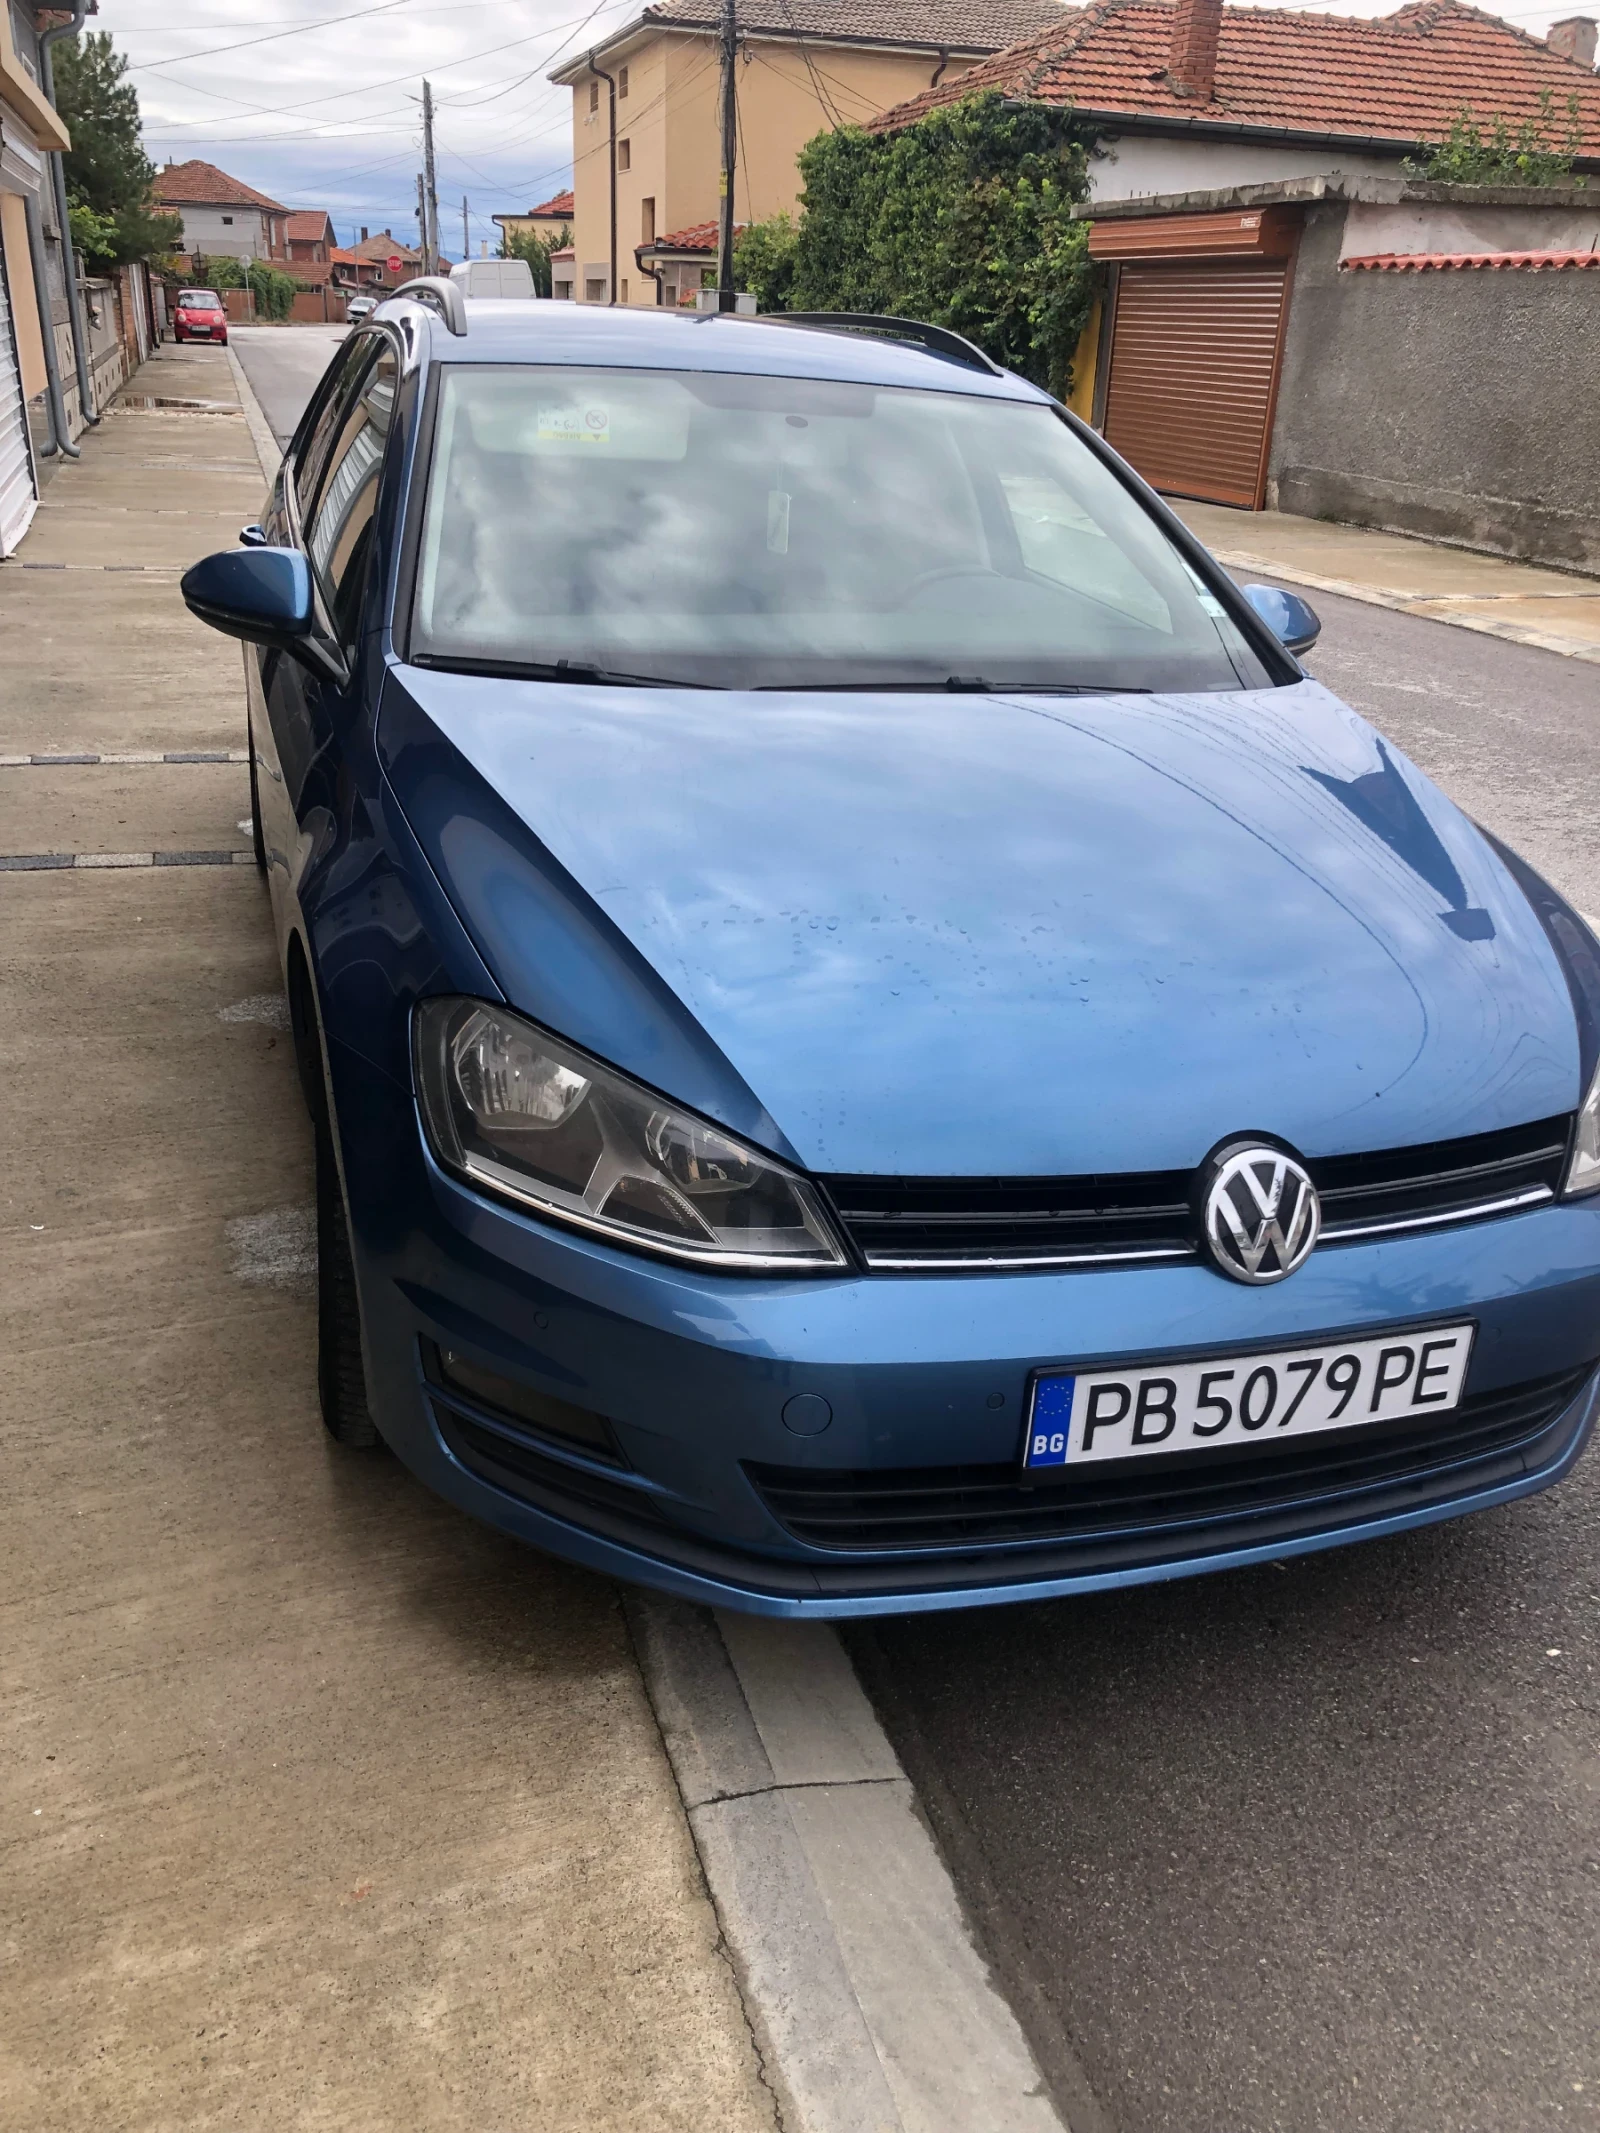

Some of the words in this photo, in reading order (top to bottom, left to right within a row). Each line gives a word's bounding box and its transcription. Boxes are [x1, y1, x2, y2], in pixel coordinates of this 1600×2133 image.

[388, 259, 402, 267] STOP
[1209, 1150, 1316, 1280] VW
[1032, 1433, 1064, 1455] BG
